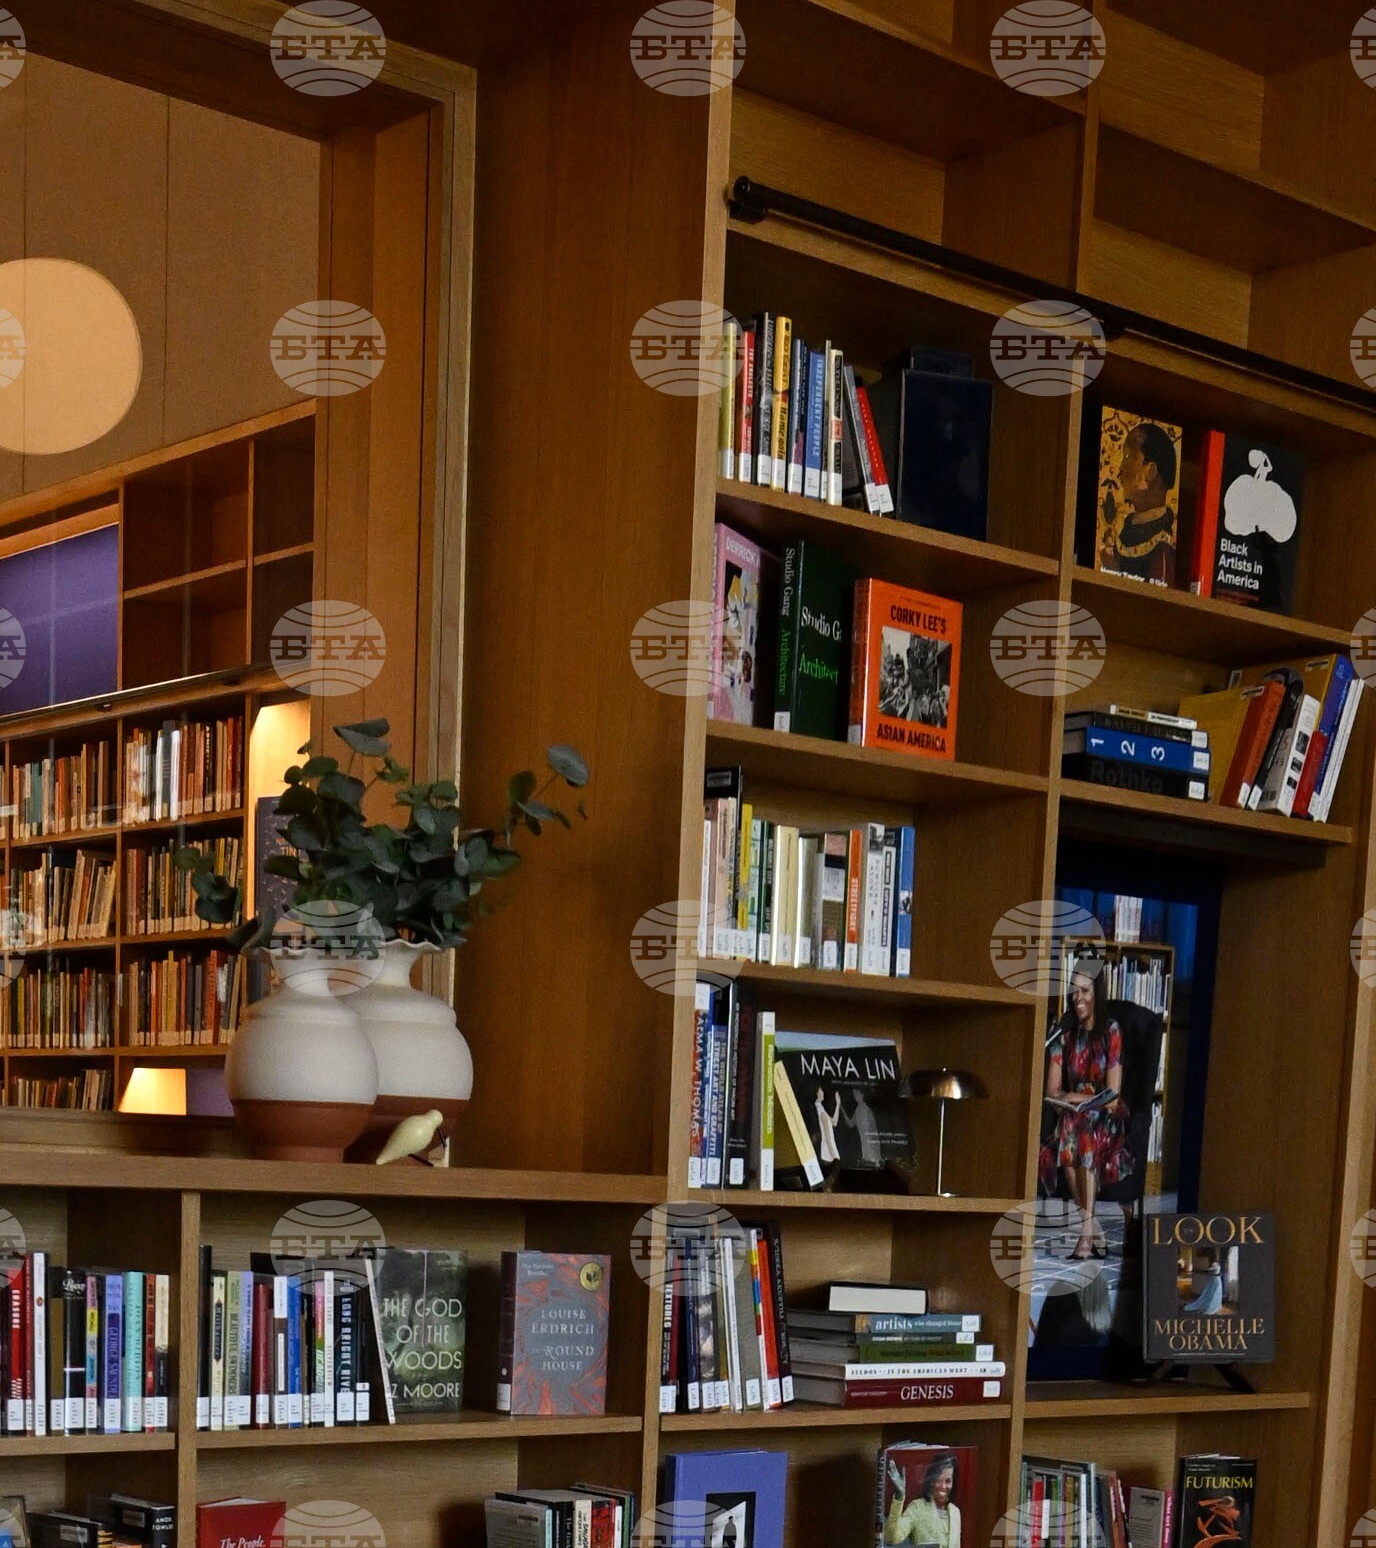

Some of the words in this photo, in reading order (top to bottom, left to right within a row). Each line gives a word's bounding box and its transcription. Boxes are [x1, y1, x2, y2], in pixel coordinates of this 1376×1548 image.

[814, 359, 824, 423] INDEPENDENT
[812, 426, 820, 456] PEOPLE
[1220, 538, 1248, 557] Black
[784, 548, 795, 585] Studio
[1218, 554, 1253, 575] Artists
[1254, 562, 1263, 575] in
[1217, 570, 1259, 590] America
[782, 586, 793, 617] Gang
[801, 606, 831, 637] Studio
[890, 605, 921, 630] CORKY
[923, 613, 947, 634] LEE'S
[779, 628, 791, 695] Architecture
[877, 723, 905, 744] ASIAN
[907, 730, 946, 753] AMERICA
[1090, 737, 1104, 748] 1
[1121, 740, 1136, 756] 2
[1151, 745, 1165, 761] 3
[1090, 762, 1164, 794] Rothko
[801, 1053, 860, 1078] MAYA
[865, 1058, 896, 1080] LIN
[691, 1080, 702, 1138] THOMAS
[1152, 1216, 1264, 1245] LOOK
[341, 1298, 351, 1323] LONG
[383, 1298, 407, 1317] THE
[414, 1299, 462, 1318] GOD
[541, 1309, 586, 1320] LOUISE
[531, 1323, 594, 1334] ERDRICH
[875, 1315, 913, 1331] artists
[1154, 1318, 1265, 1335] MICHELLE
[396, 1325, 419, 1344] OF
[426, 1325, 449, 1344] THE
[1169, 1334, 1248, 1351] OBAMA
[341, 1327, 351, 1366] BRIGHT
[545, 1345, 594, 1360] ROUND
[386, 1351, 462, 1370] WOODS
[542, 1361, 584, 1371] HOUSE
[912, 1367, 948, 1375] AMERICAN
[403, 1382, 460, 1398] MOORE
[900, 1384, 954, 1401] GENESIS
[1186, 1476, 1253, 1489] FUTURISM
